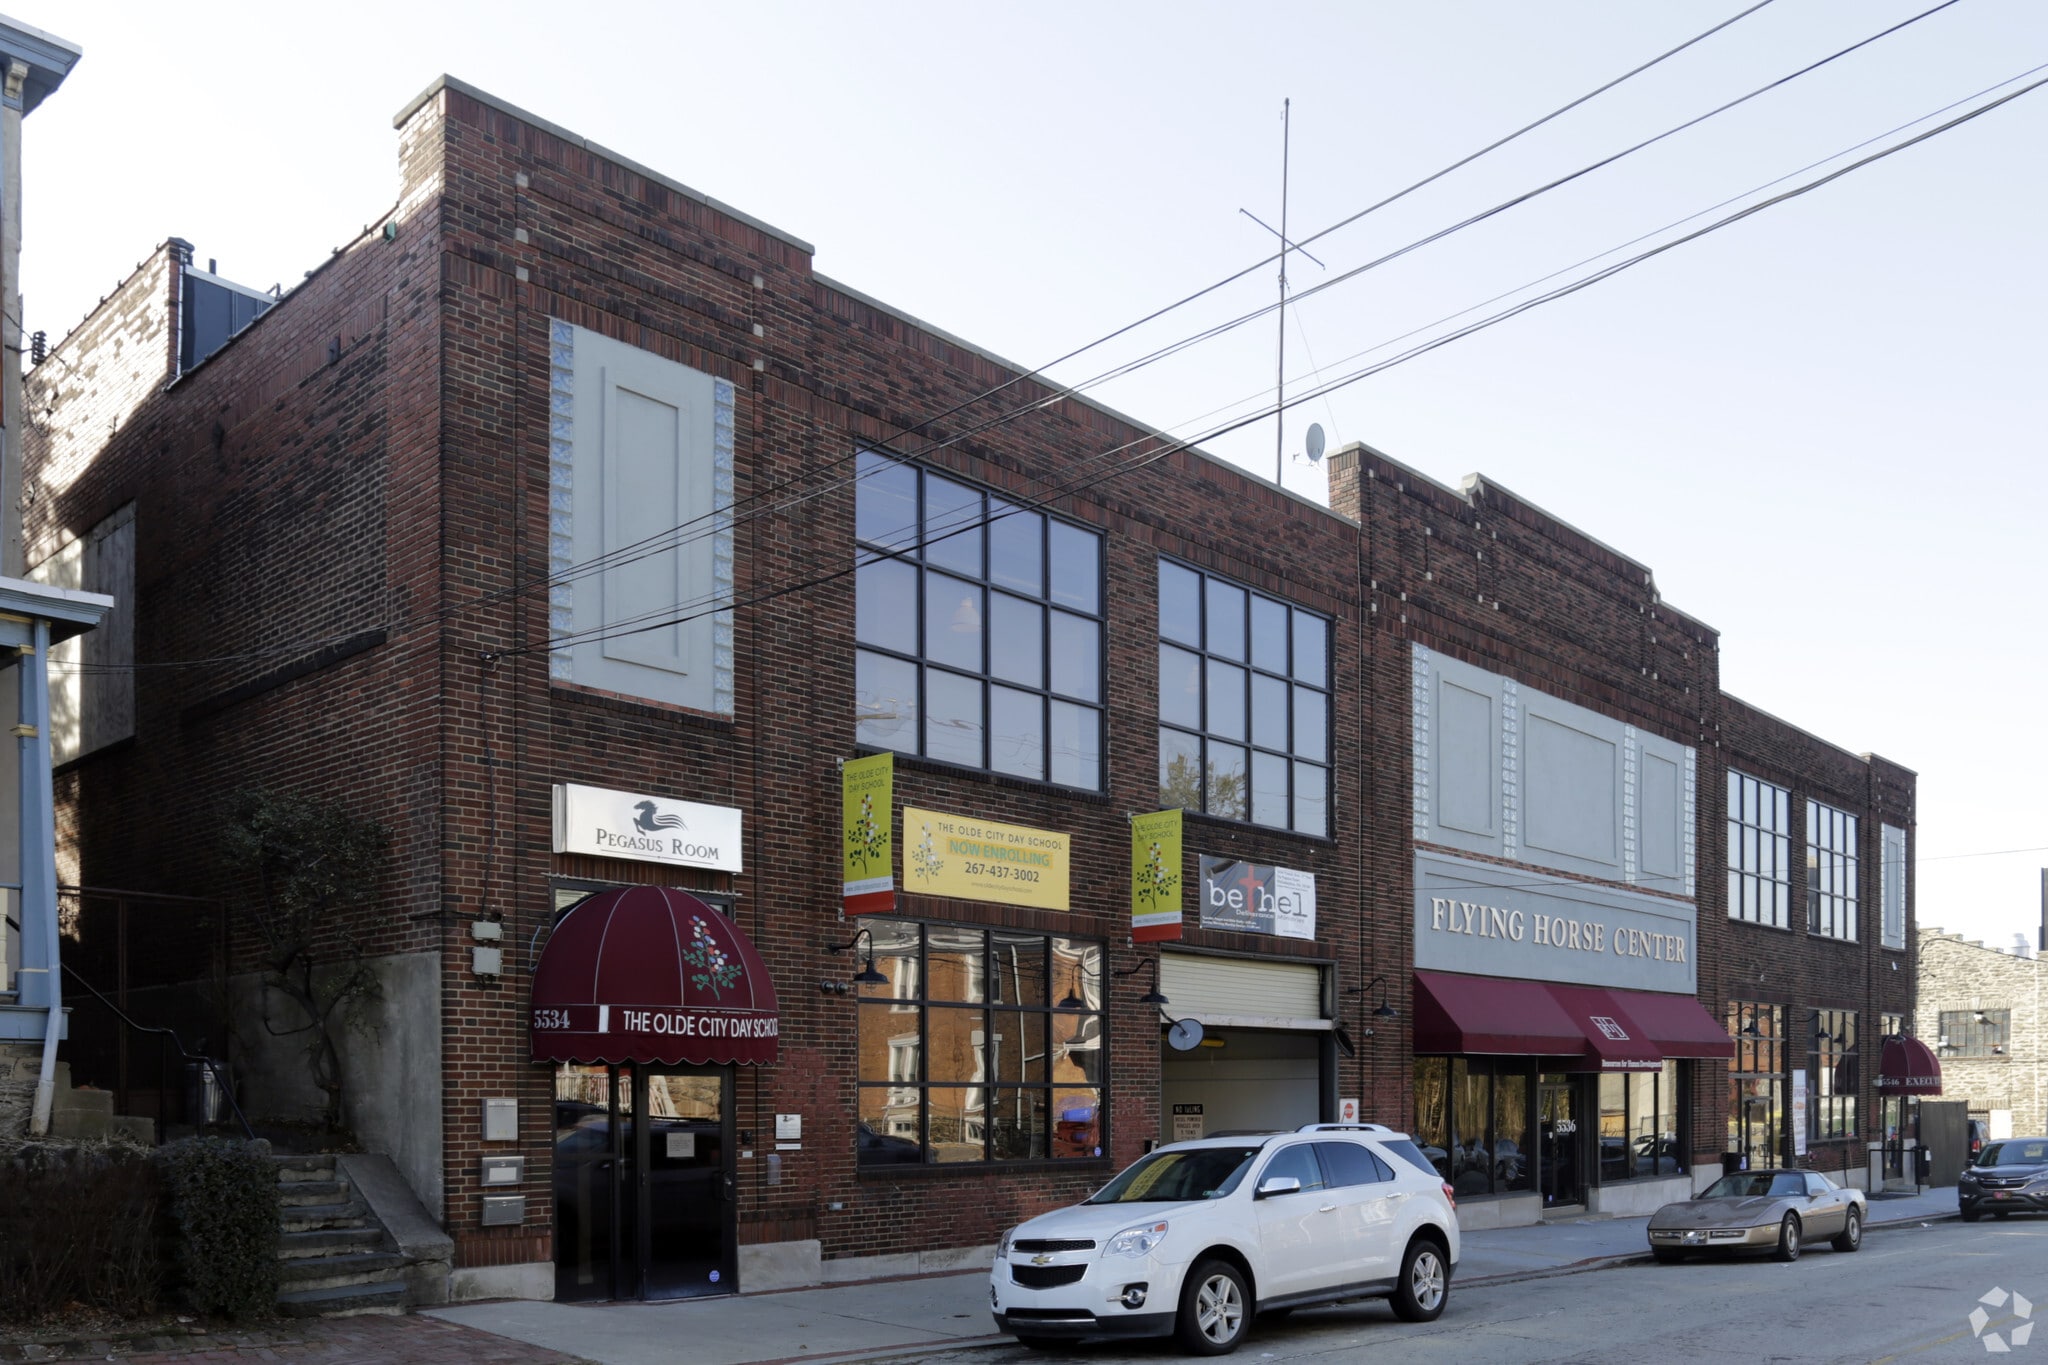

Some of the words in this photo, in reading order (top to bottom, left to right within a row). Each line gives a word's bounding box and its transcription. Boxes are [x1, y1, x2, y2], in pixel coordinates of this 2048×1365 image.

[938, 822, 954, 833] THE
[958, 826, 982, 838] OLDE
[986, 830, 1005, 841] CITY
[1008, 834, 1025, 844] DAY
[1028, 837, 1062, 850] SCHOOL
[949, 839, 980, 857] NOW
[983, 845, 1050, 867] ENROLLING
[965, 861, 1040, 883] 267-437-3002
[1207, 865, 1308, 918] bethel
[1431, 897, 1524, 942] FLYING
[1533, 914, 1605, 952] HORSE
[1613, 928, 1687, 963] CENTER
[534, 1009, 570, 1029] 5534
[623, 1010, 651, 1032] THE
[653, 1013, 695, 1036] OLDE
[698, 1016, 728, 1037] CITY
[730, 1018, 753, 1038] DAY
[1175, 1105, 1183, 1113] NO
[1556, 1119, 1576, 1133] 5536
